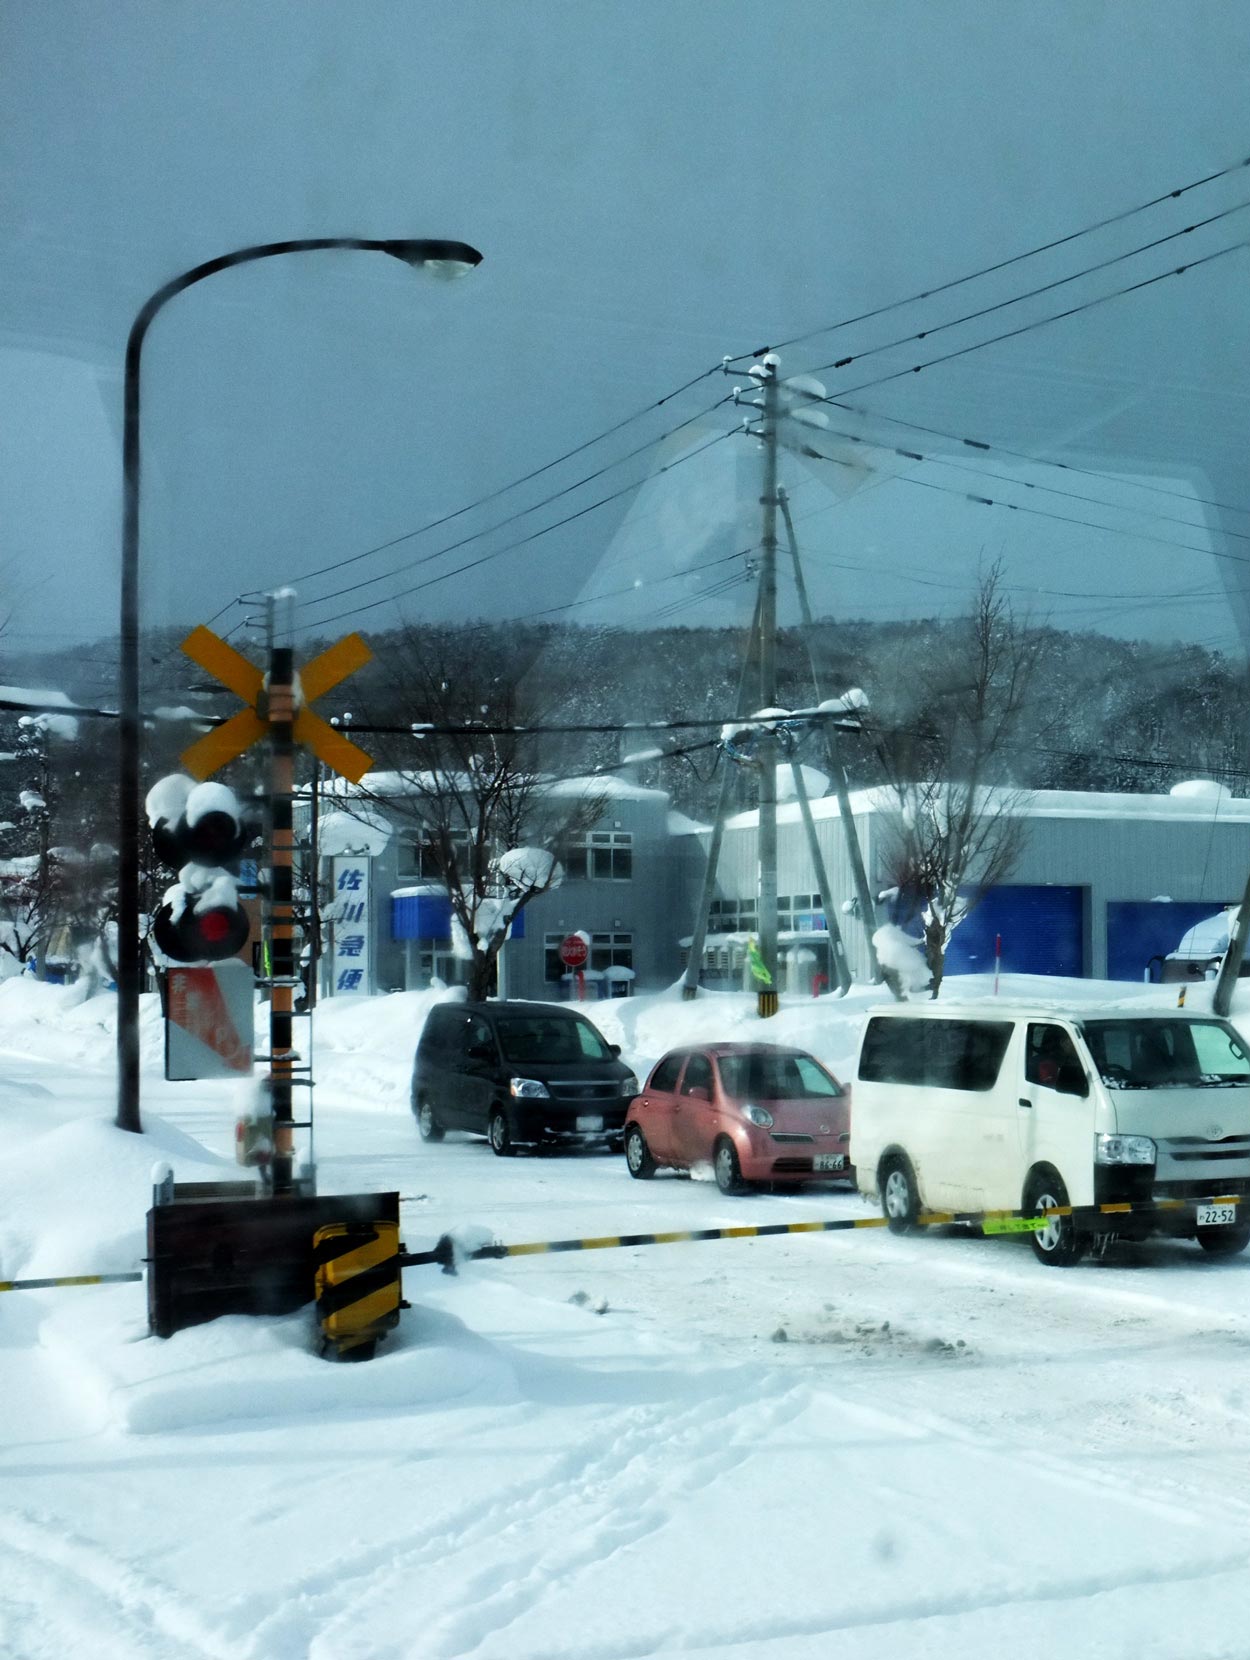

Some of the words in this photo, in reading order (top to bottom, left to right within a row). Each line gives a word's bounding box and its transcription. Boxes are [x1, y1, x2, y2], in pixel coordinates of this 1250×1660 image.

[337, 869, 365, 991] 佐川急便
[1205, 1210, 1234, 1224] 22-52
